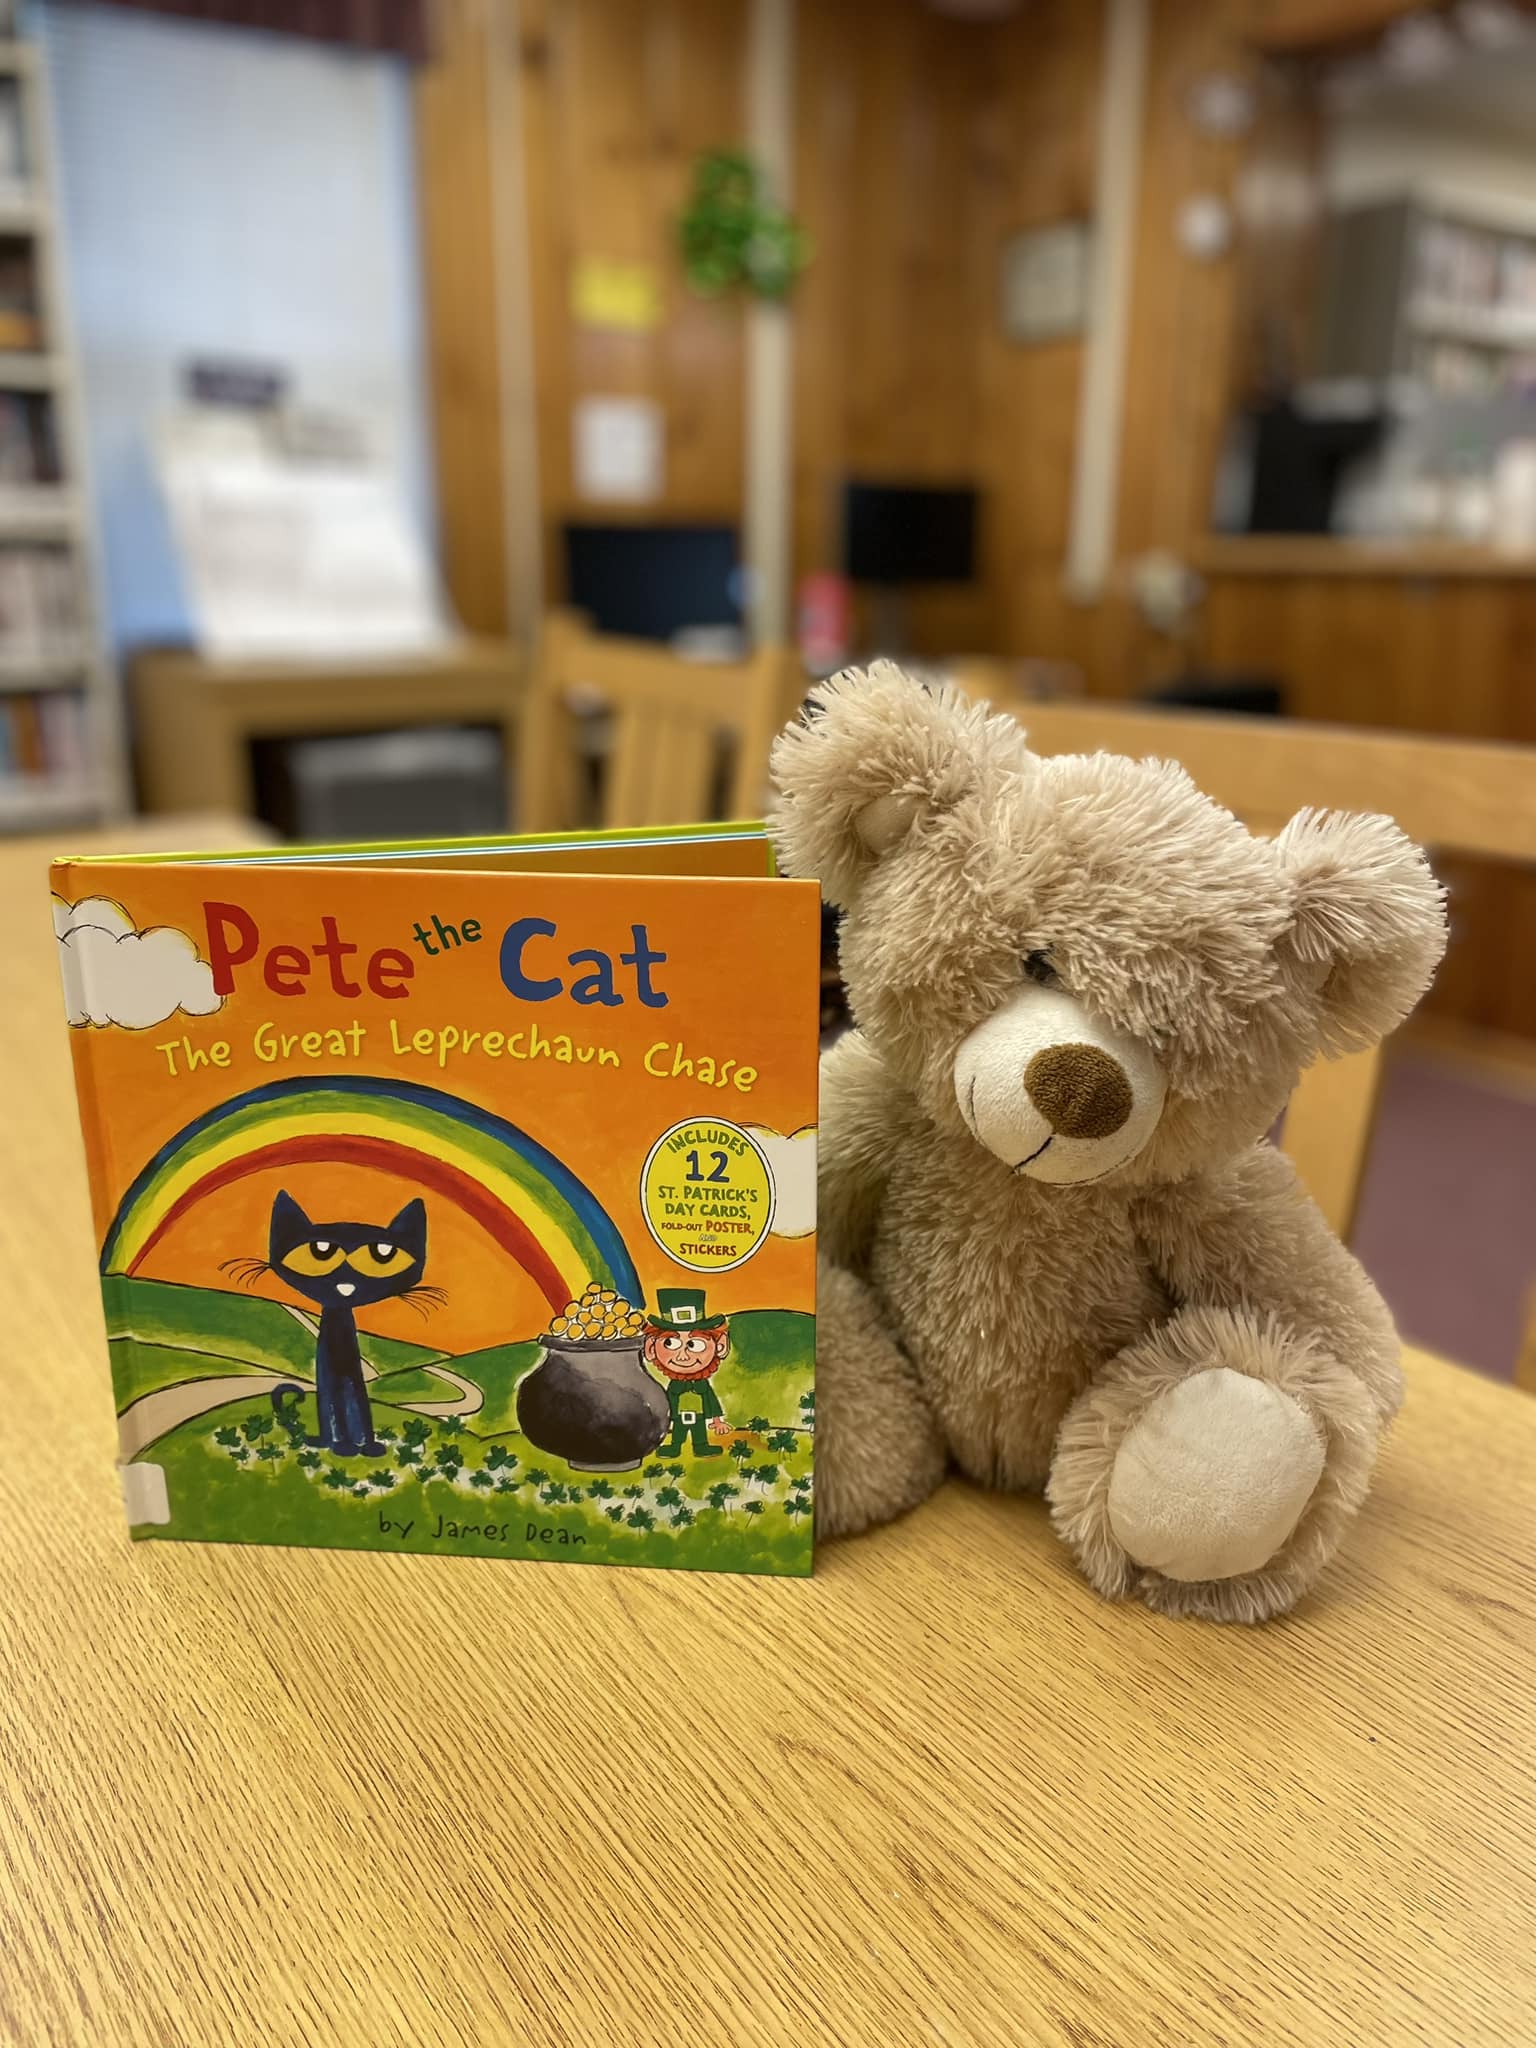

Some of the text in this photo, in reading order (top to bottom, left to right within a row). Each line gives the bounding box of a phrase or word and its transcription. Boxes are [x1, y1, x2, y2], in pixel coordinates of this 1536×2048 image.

[202, 901, 669, 1008] Pete the Cat
[156, 1018, 758, 1092] The Great Leprechaun Chase
[666, 1129, 749, 1156] INCLUDES
[685, 1150, 730, 1183] 12
[658, 1185, 758, 1203] ST. PATRICK'S
[665, 1203, 751, 1220] DAY CARDS,
[661, 1220, 755, 1235] FOLD-OUT POSTER,
[679, 1243, 737, 1256] STICKERS
[379, 1510, 587, 1545] by James Dean
